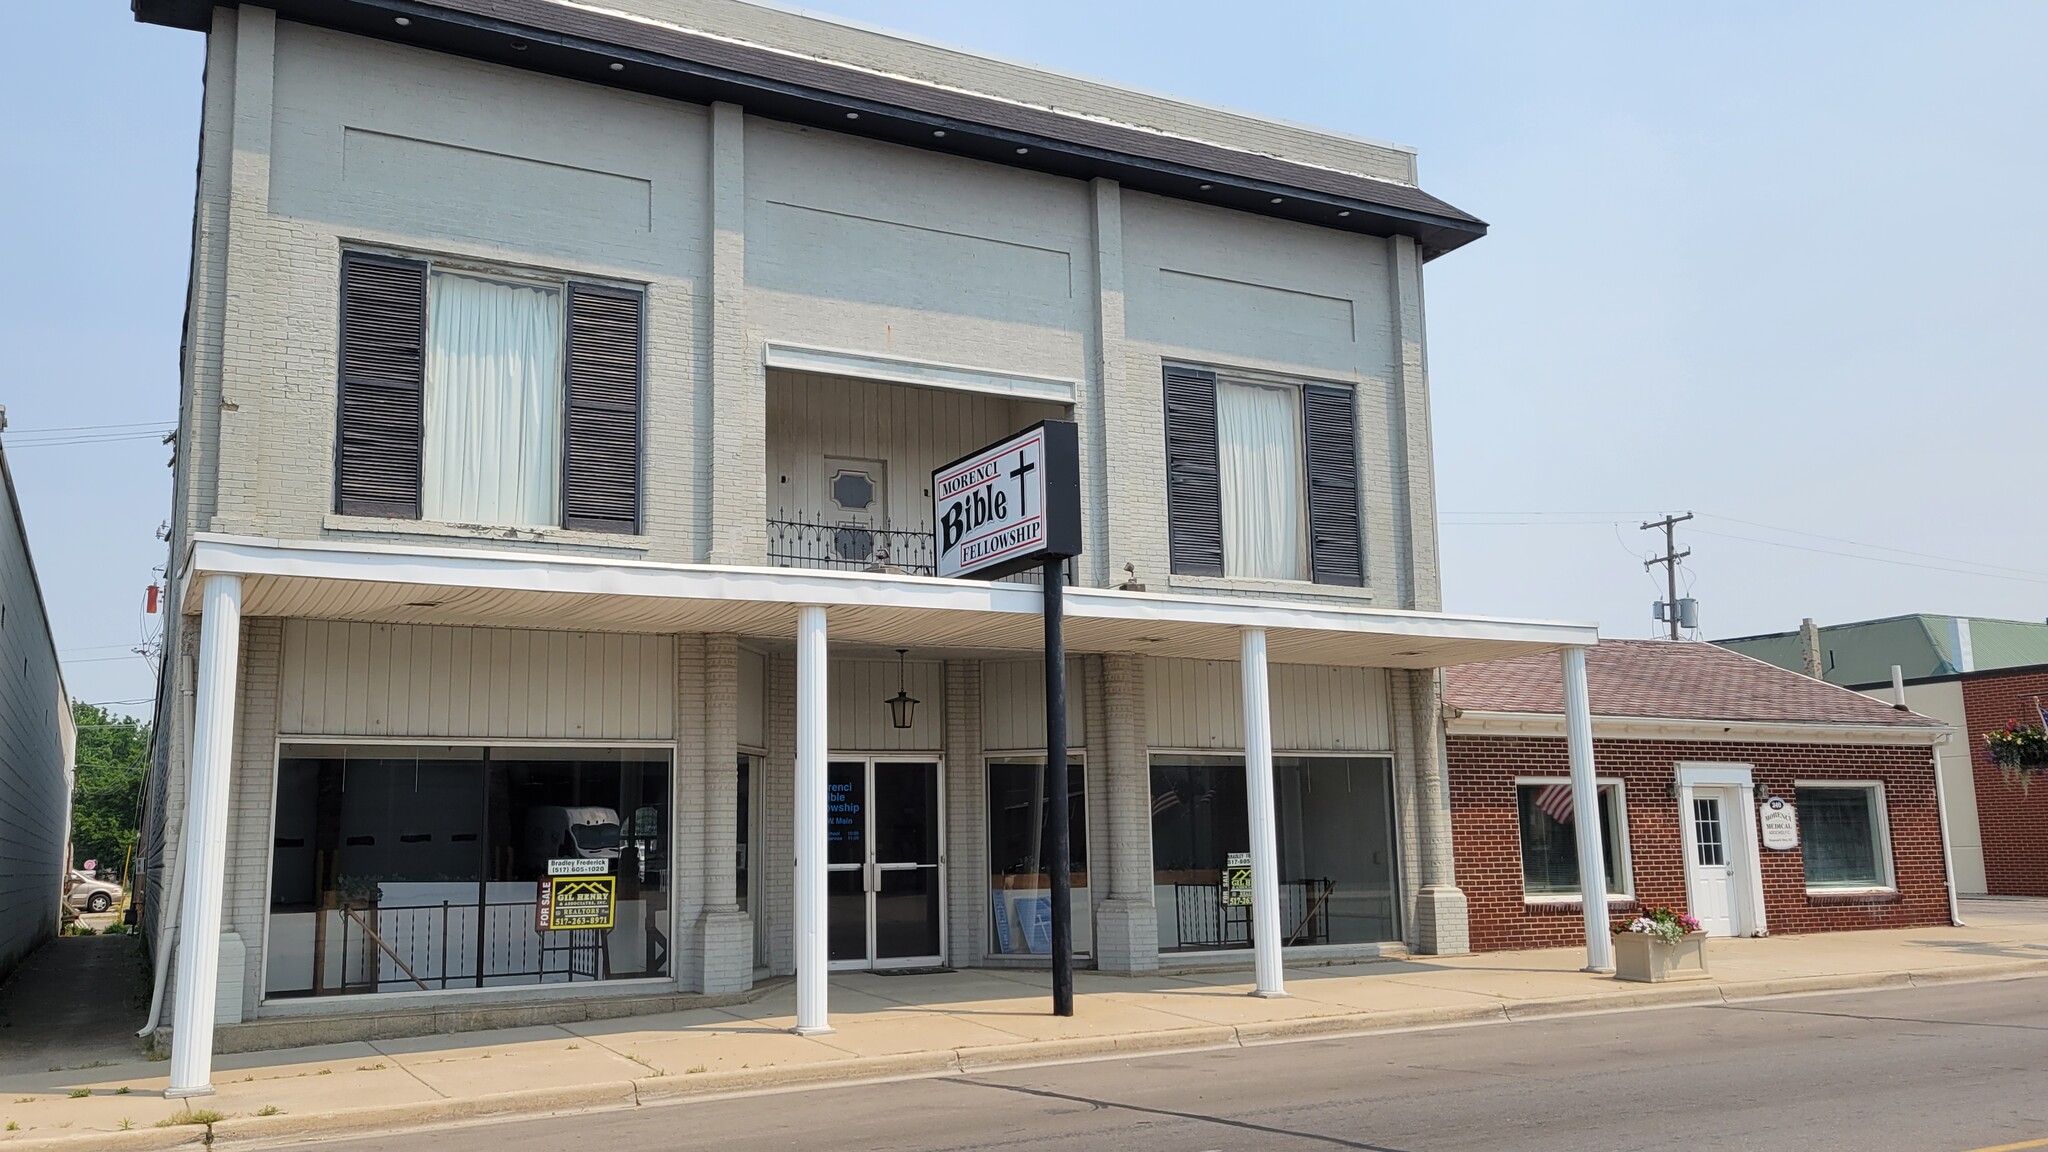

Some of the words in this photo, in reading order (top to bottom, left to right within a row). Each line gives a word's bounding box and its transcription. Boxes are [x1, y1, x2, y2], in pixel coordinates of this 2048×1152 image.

[942, 460, 998, 496] MORENCI
[940, 483, 1007, 558] Bible
[962, 521, 1040, 562] FELLOWSHIP
[827, 782, 852, 792] renci
[836, 817, 853, 825] Main
[541, 881, 551, 906] SALE
[557, 893, 575, 901] GIL
[576, 892, 609, 901] HENRY
[540, 907, 550, 926] FOR
[555, 916, 608, 926] 517-263-8971
